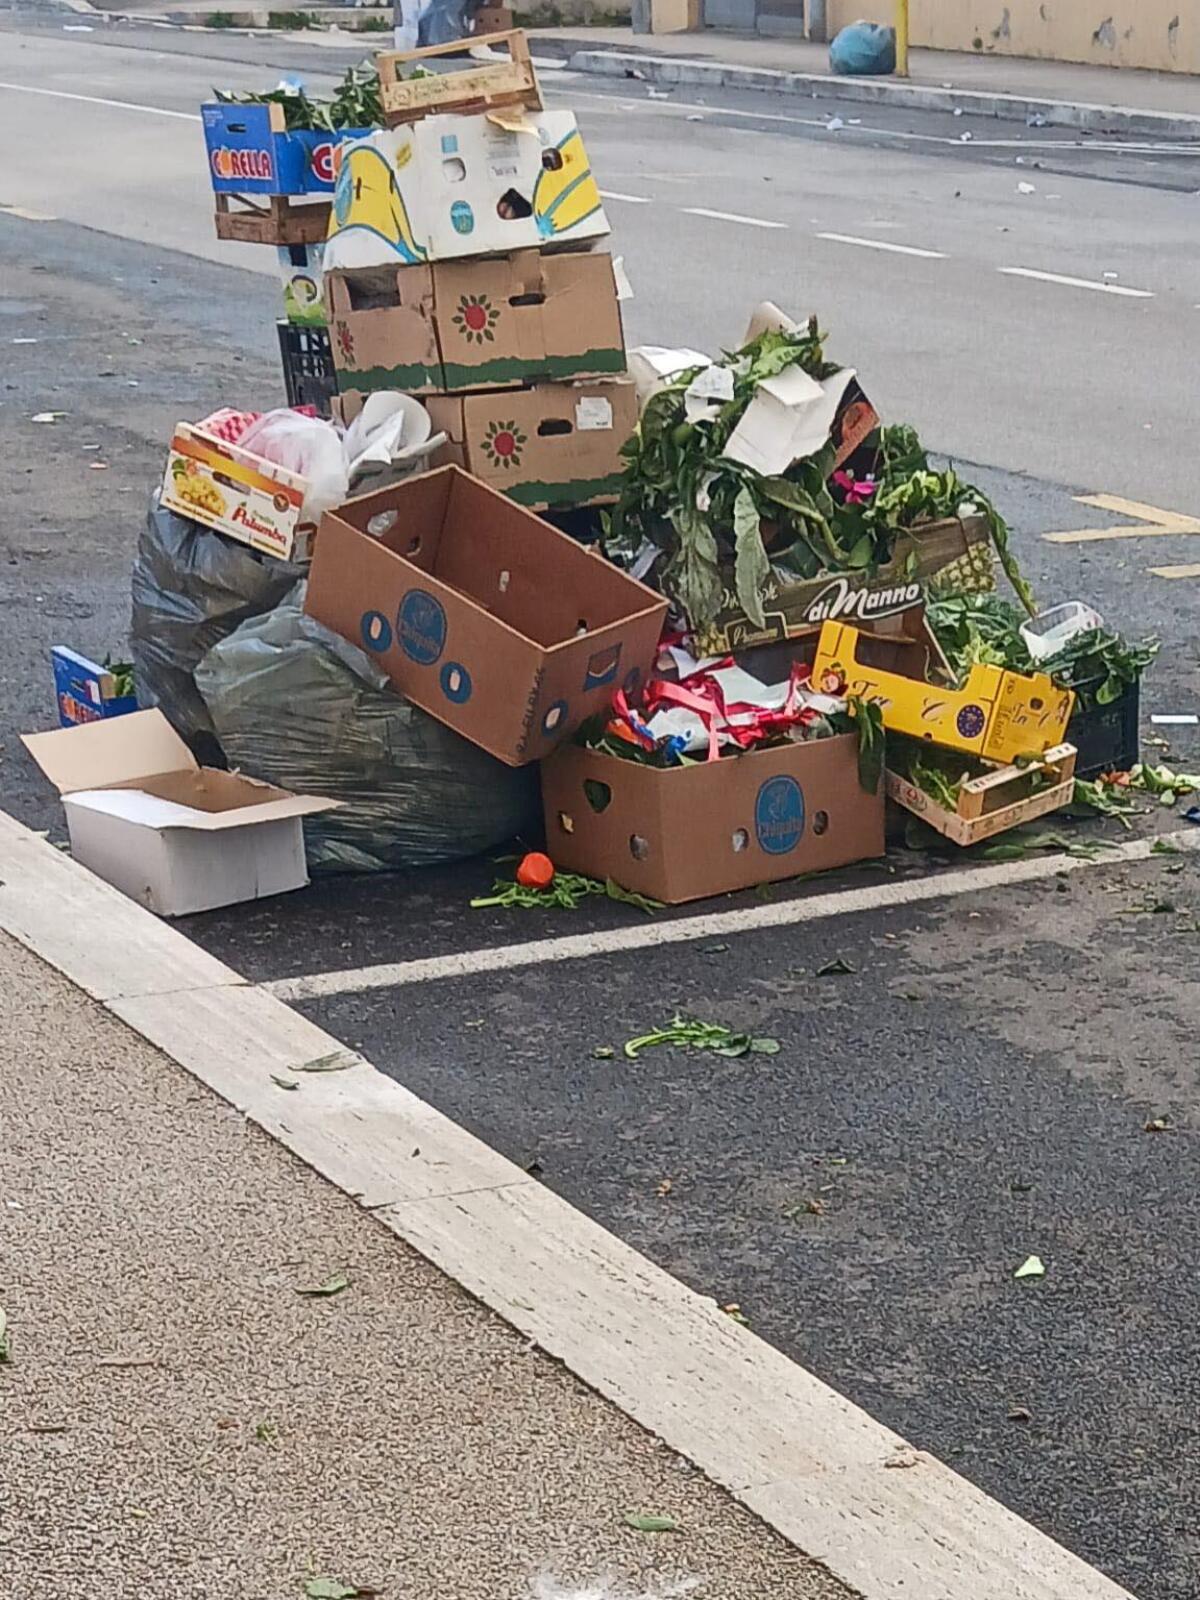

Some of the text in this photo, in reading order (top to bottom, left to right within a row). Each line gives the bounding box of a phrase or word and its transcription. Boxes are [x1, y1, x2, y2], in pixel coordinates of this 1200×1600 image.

[211, 148, 273, 180] CORELLA
[803, 578, 922, 620] Manno
[808, 599, 833, 622] di
